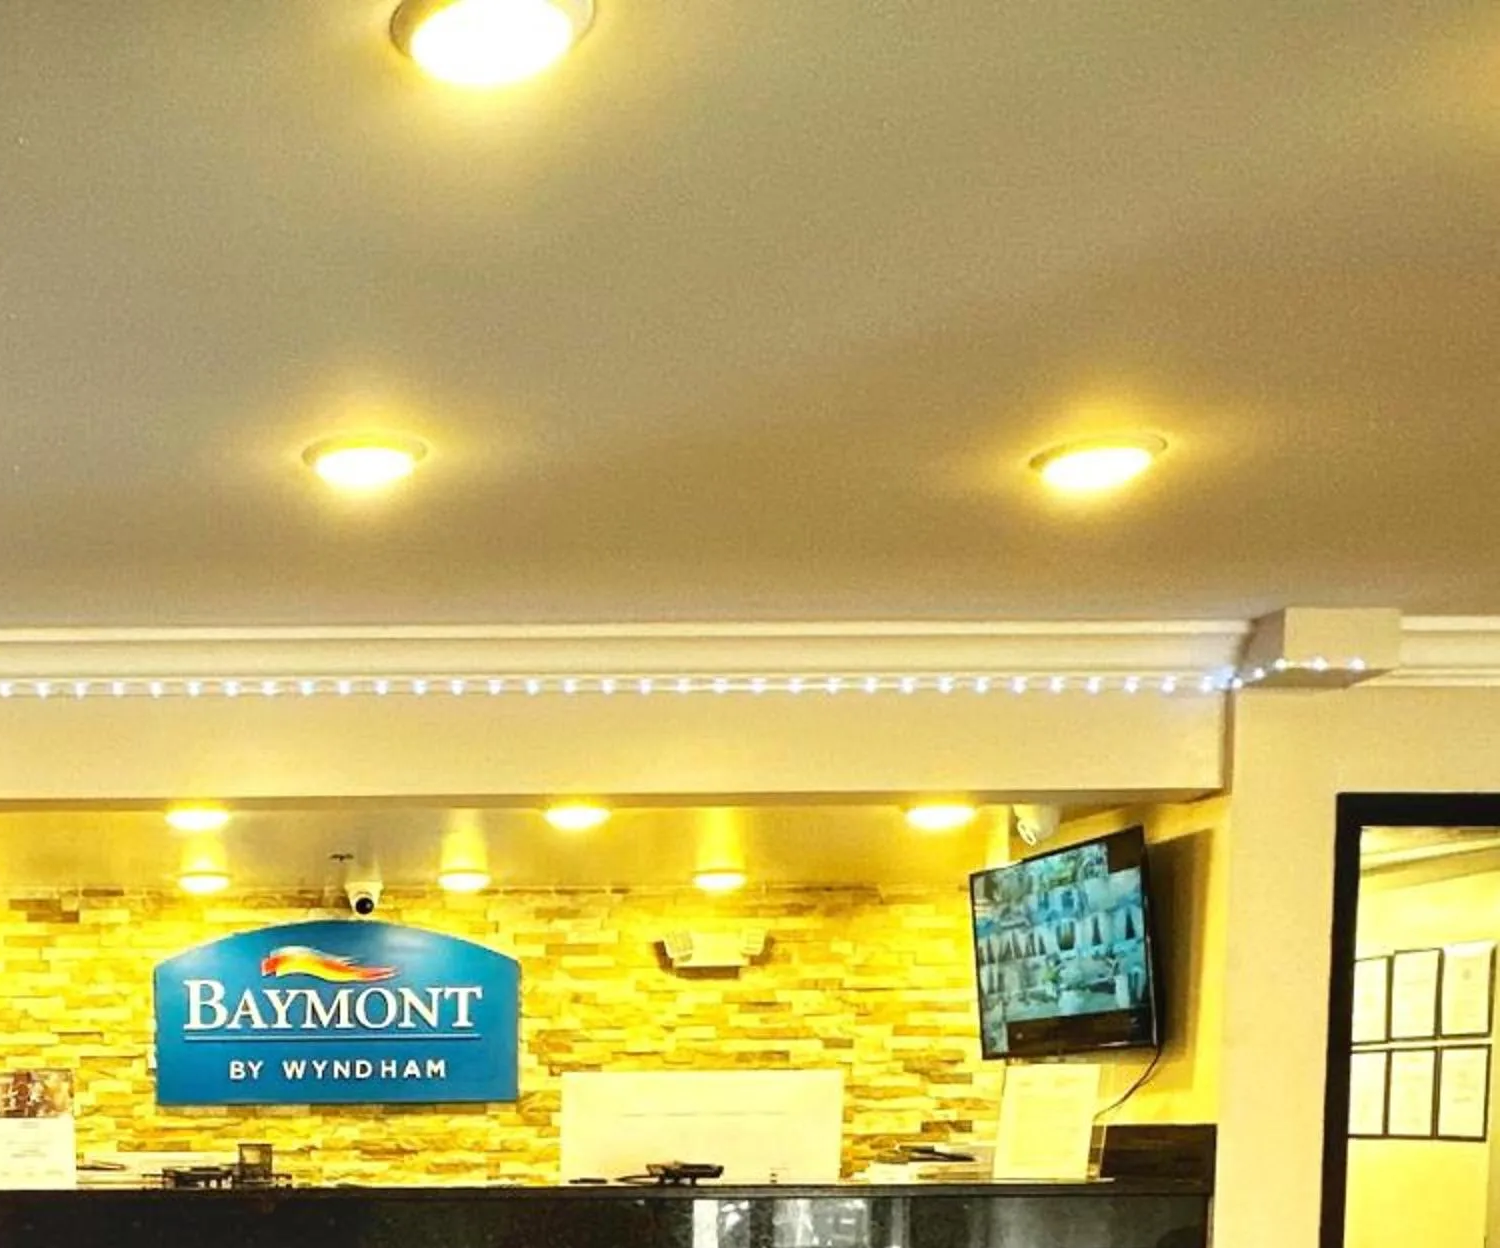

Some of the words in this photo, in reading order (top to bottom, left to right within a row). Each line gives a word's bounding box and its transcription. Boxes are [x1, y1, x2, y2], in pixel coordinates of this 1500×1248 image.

[182, 979, 482, 1030] BAYMONT
[229, 1060, 264, 1080] BY
[283, 1059, 446, 1080] WYNDHAM
